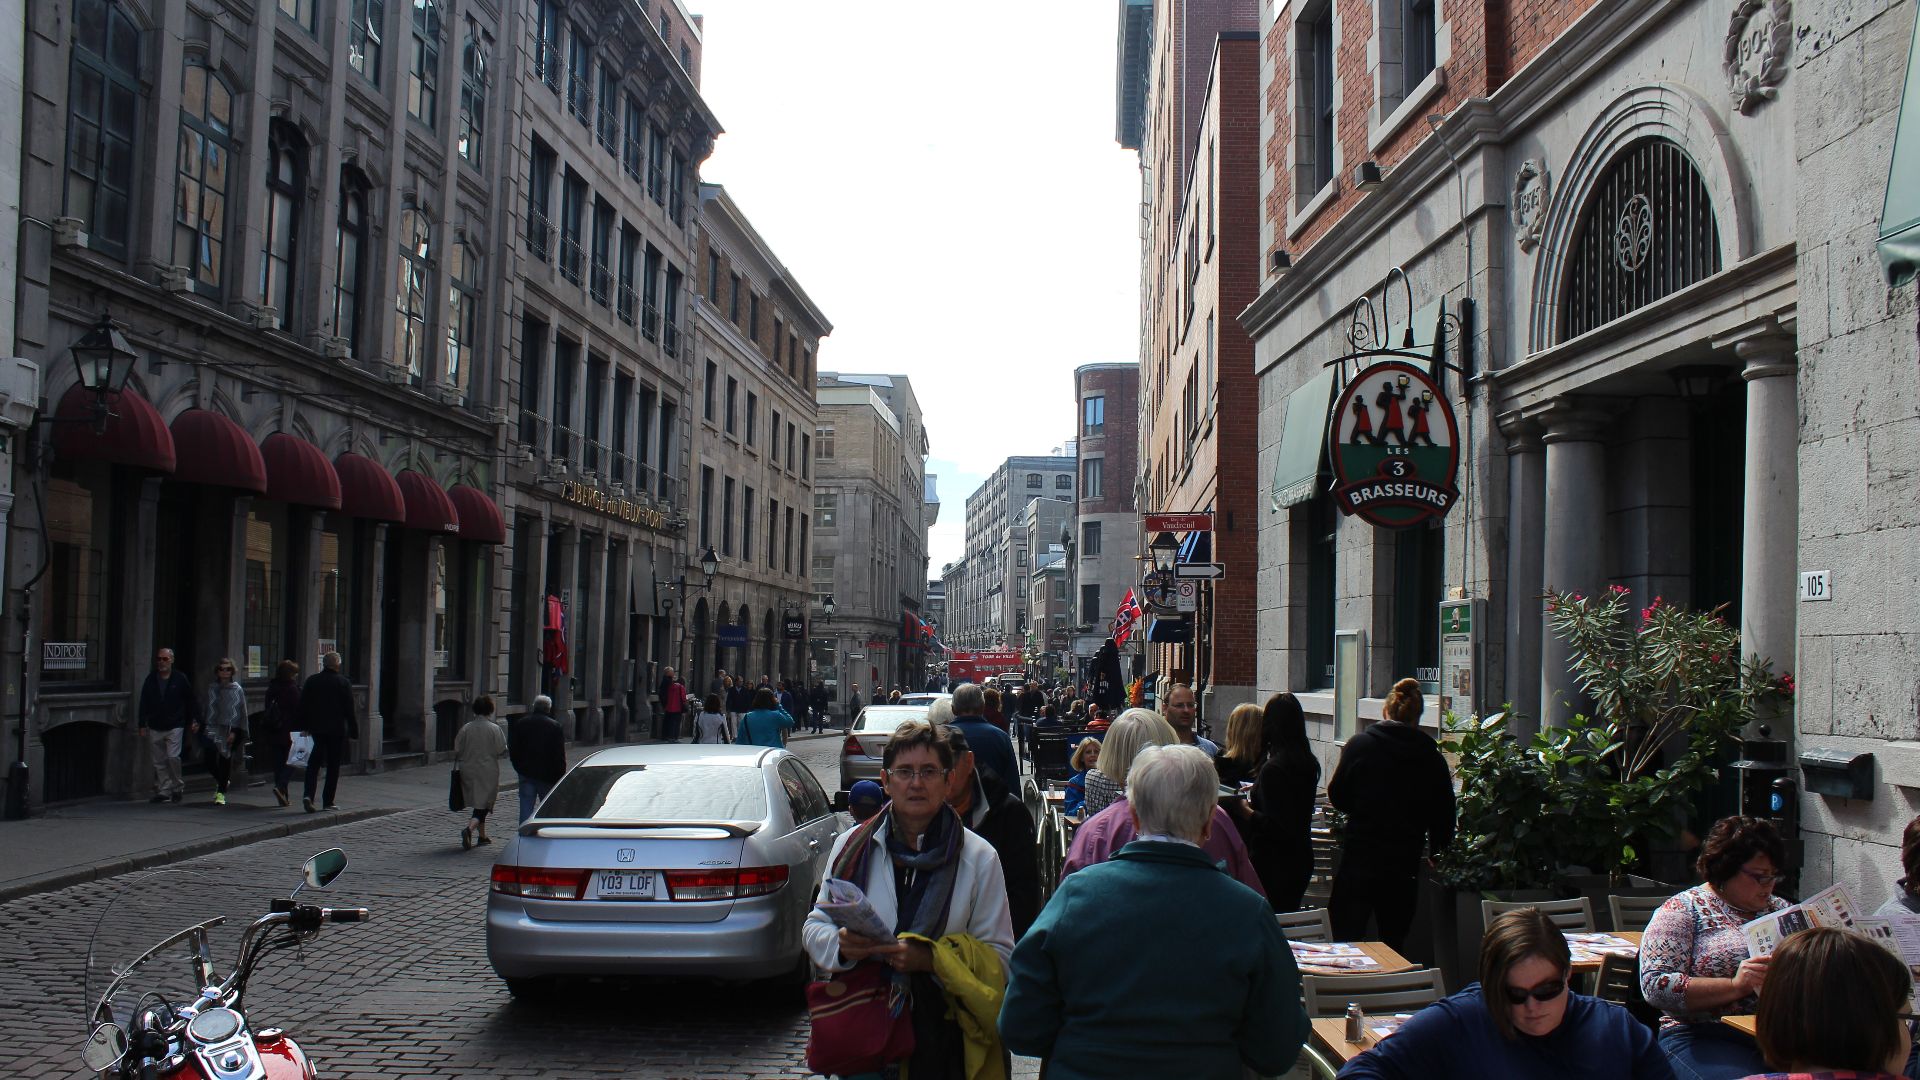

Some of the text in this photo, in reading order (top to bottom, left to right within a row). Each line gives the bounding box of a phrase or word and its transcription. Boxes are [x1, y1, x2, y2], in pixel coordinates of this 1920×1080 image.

[1387, 447, 1409, 455] LES
[1393, 461, 1405, 476] 3
[1350, 484, 1448, 506] BRASSEURS
[1807, 575, 1823, 597] 105
[44, 645, 87, 658] INDIPORT
[630, 876, 652, 891] LDF
